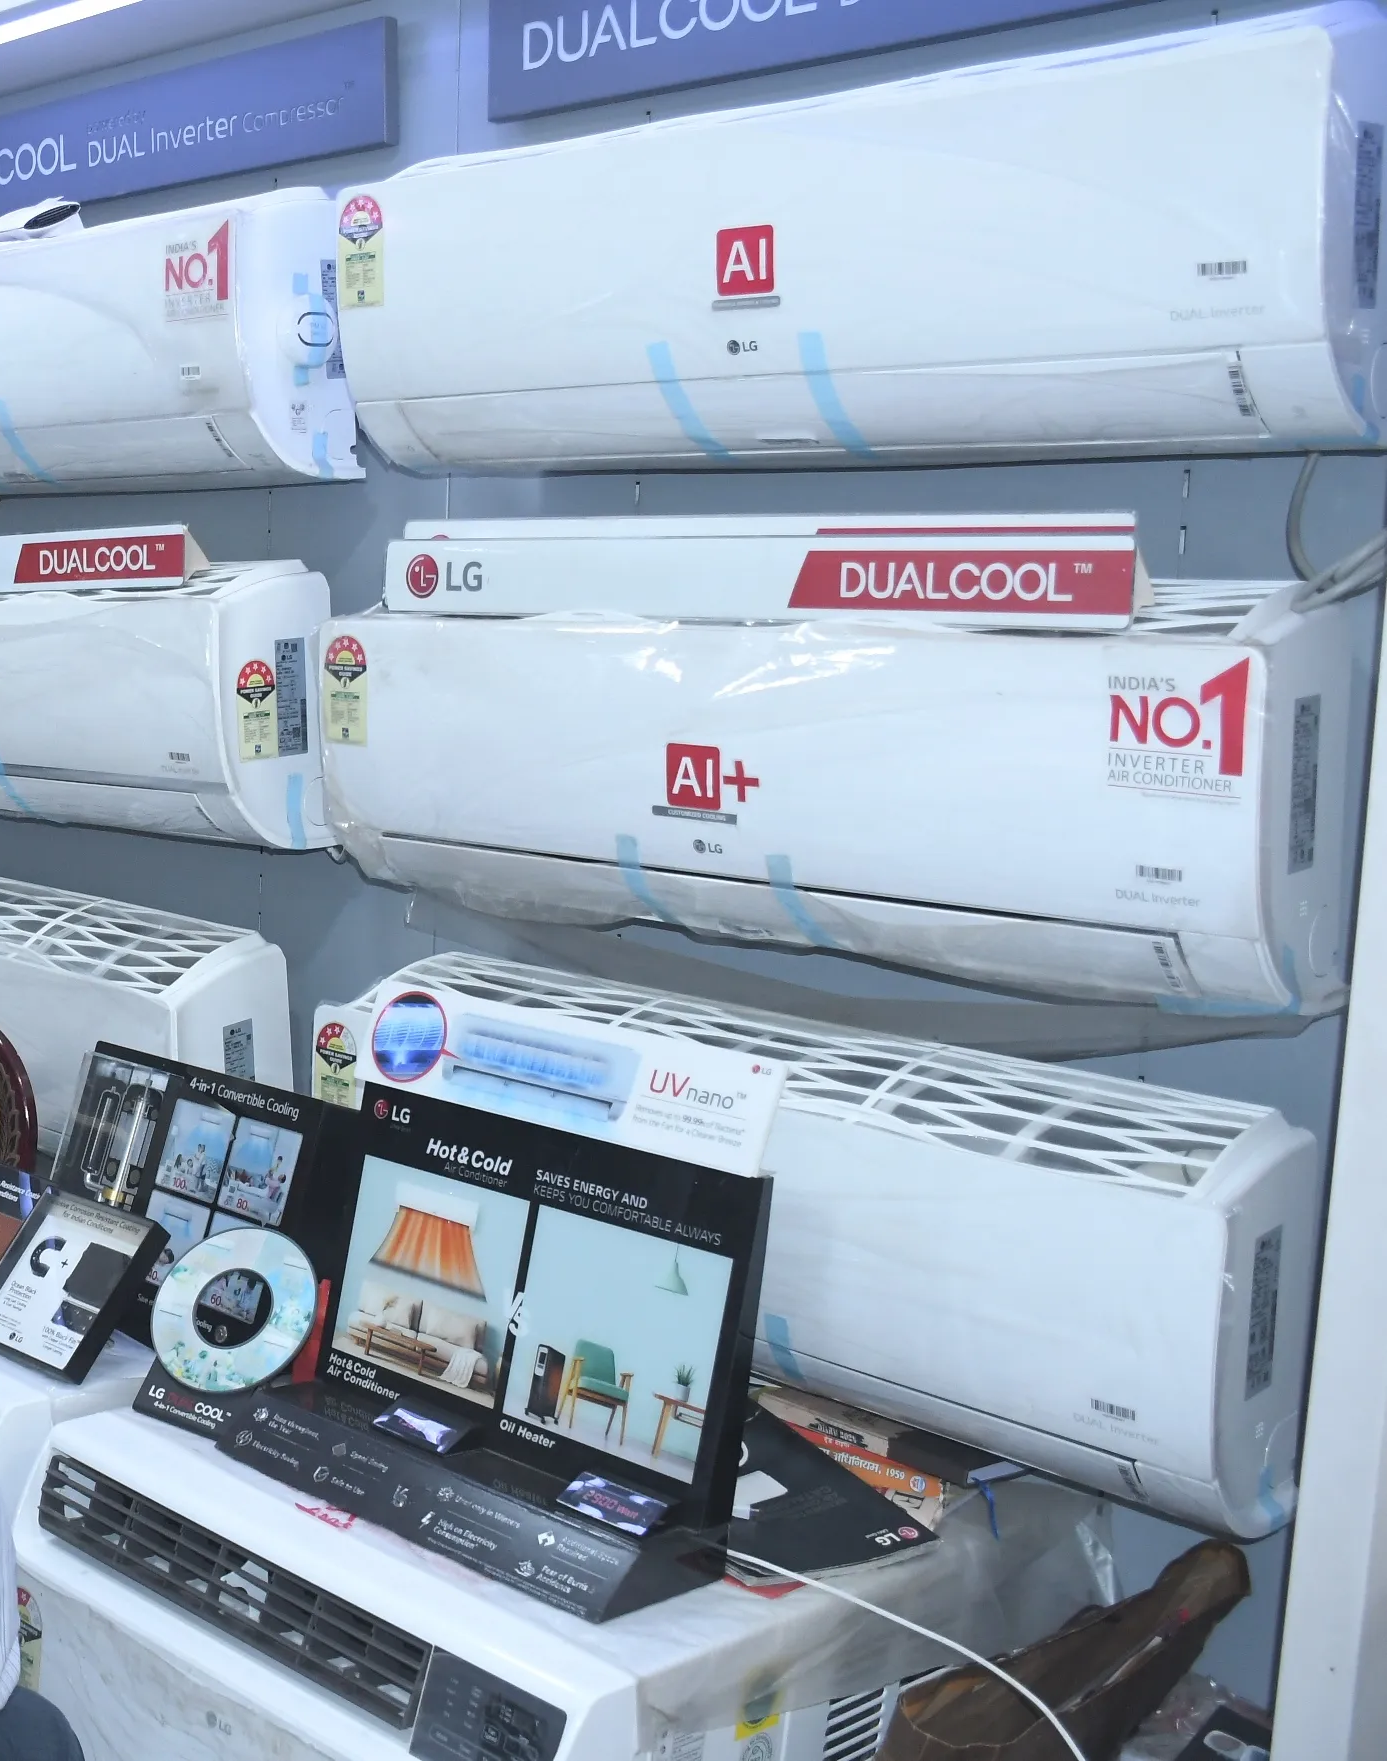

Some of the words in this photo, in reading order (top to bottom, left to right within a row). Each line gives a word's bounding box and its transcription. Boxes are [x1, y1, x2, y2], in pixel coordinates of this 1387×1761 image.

[523, 0, 817, 70] DUALCO
[88, 131, 145, 167] DUAL
[150, 115, 238, 154] Inverter
[242, 97, 345, 133] Compressor
[165, 240, 197, 255] INDIA'S
[722, 238, 767, 283] AI
[742, 340, 758, 353] LG
[445, 562, 483, 592] LG
[1107, 675, 1176, 692] INDIA'S
[1109, 656, 1250, 777] NO.1
[1107, 752, 1204, 775] INVERTER
[1107, 769, 1129, 783] AIR
[1132, 771, 1232, 793] CONDITIONER
[707, 842, 723, 854] LG
[1115, 888, 1148, 902] DUAL
[1152, 892, 1202, 908] Inverter
[319, 1048, 335, 1057] POWER
[334, 1052, 353, 1062] SAVINGS
[761, 1067, 772, 1076] LG
[189, 1077, 216, 1095] 4-in-1
[217, 1084, 266, 1109] Convertible
[266, 1098, 300, 1122] Cooling
[391, 1105, 411, 1124] LG
[444, 1162, 457, 1174] Air
[458, 1165, 508, 1188] Conditioner
[0, 1178, 25, 1195] Resistance
[536, 1169, 570, 1189] SAVES
[572, 1179, 620, 1202] ENERGY
[621, 1192, 648, 1209] AND
[62, 1210, 71, 1219] for
[71, 1213, 86, 1225] Indian
[85, 1218, 114, 1235] Conditions
[70, 1204, 94, 1218] Corrosion
[94, 1211, 119, 1226] Resistant
[119, 1218, 141, 1234] Coating
[533, 1183, 566, 1202] KEEPS
[568, 1193, 590, 1209] YOU
[592, 1200, 672, 1233] COMFORTABLE
[674, 1222, 722, 1246] ALWAYS
[9, 1287, 32, 1300] Protection
[10, 1280, 25, 1290] Ocean
[25, 1286, 37, 1295] Black
[15, 1335, 24, 1344] LG
[42, 1325, 55, 1336] 100%
[148, 1384, 166, 1400] LG
[327, 1364, 343, 1378] Air
[343, 1369, 401, 1401] Conditioner
[154, 1400, 170, 1411] 4-in-1
[169, 1404, 198, 1424] Convertible
[197, 1416, 216, 1430] Cooling
[268, 1421, 279, 1430] the
[499, 1418, 516, 1434] Oil
[517, 1425, 556, 1449] Heater
[1072, 1410, 1108, 1432] DUAL
[1110, 1421, 1161, 1447] Inverter
[885, 1467, 906, 1480] 1959
[331, 1476, 345, 1488] Safe
[344, 1482, 353, 1490] to
[352, 1485, 365, 1496] Use
[438, 1519, 454, 1531] High
[454, 1527, 464, 1535] on
[463, 1530, 498, 1551] Electricity
[874, 1531, 901, 1546] LG
[541, 1565, 558, 1576] Fear
[557, 1572, 568, 1581] of
[536, 1573, 572, 1594] Accidents
[218, 1719, 232, 1736] LG
